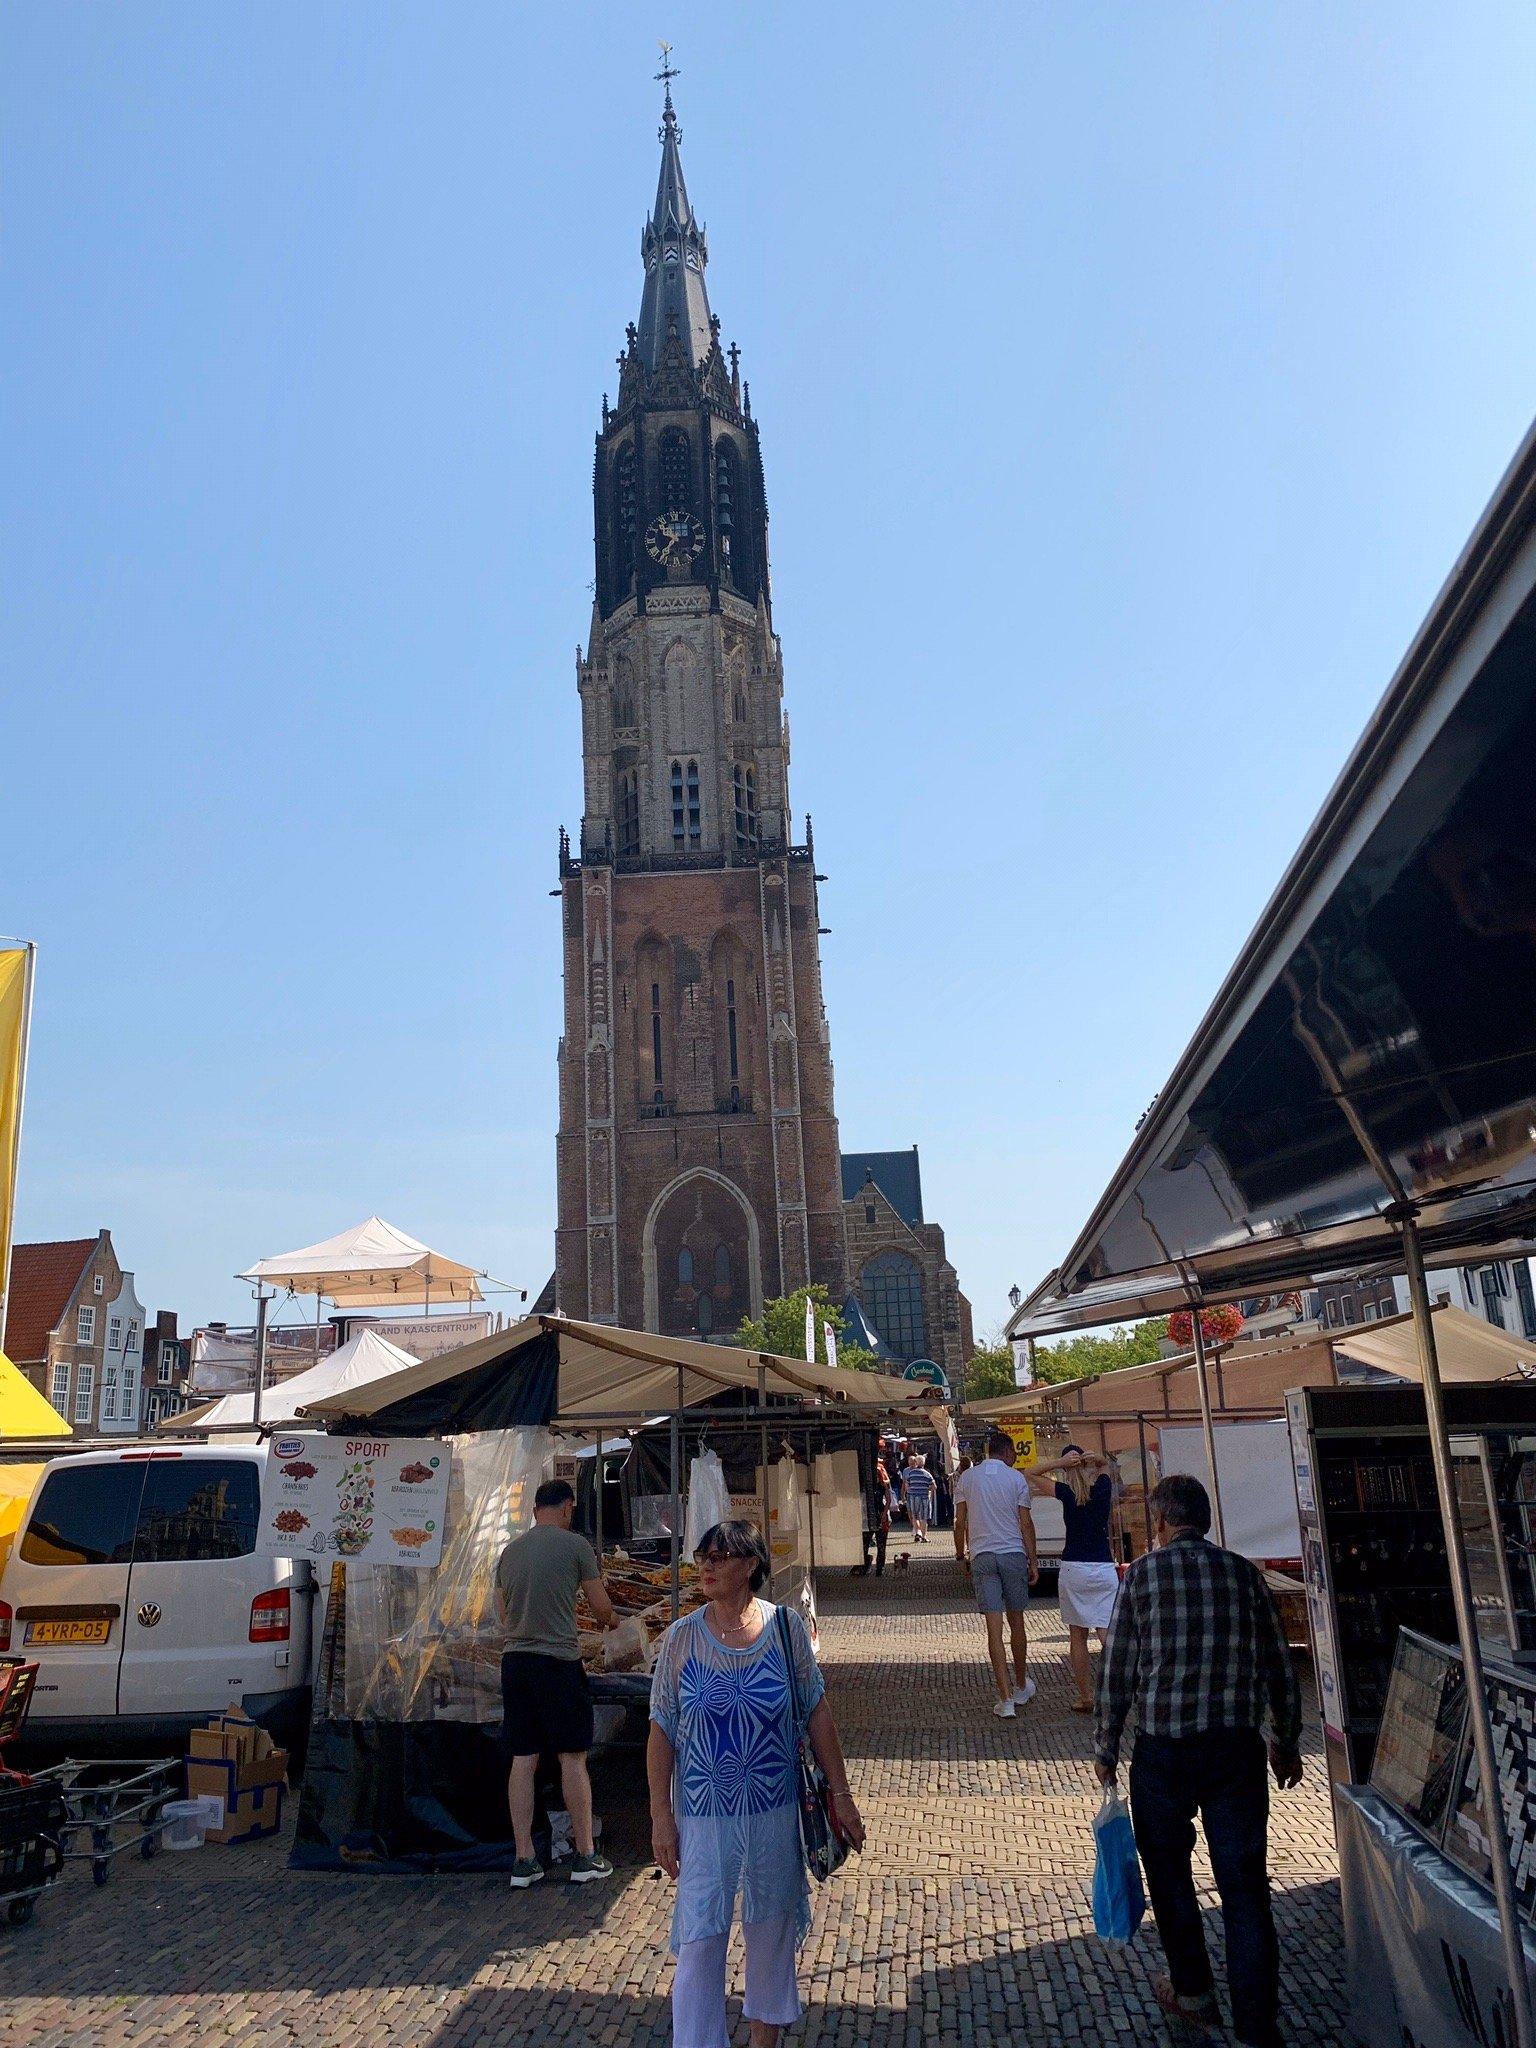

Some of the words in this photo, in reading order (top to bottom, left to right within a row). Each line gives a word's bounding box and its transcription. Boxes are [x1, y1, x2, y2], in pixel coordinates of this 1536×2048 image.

[357, 1327, 400, 1336] HLAND
[404, 1323, 477, 1334] KAASCENTRUM
[345, 1441, 390, 1458] SPORT
[730, 1498, 766, 1507] SNACKE
[36, 1622, 103, 1639] 4-VRP-05
